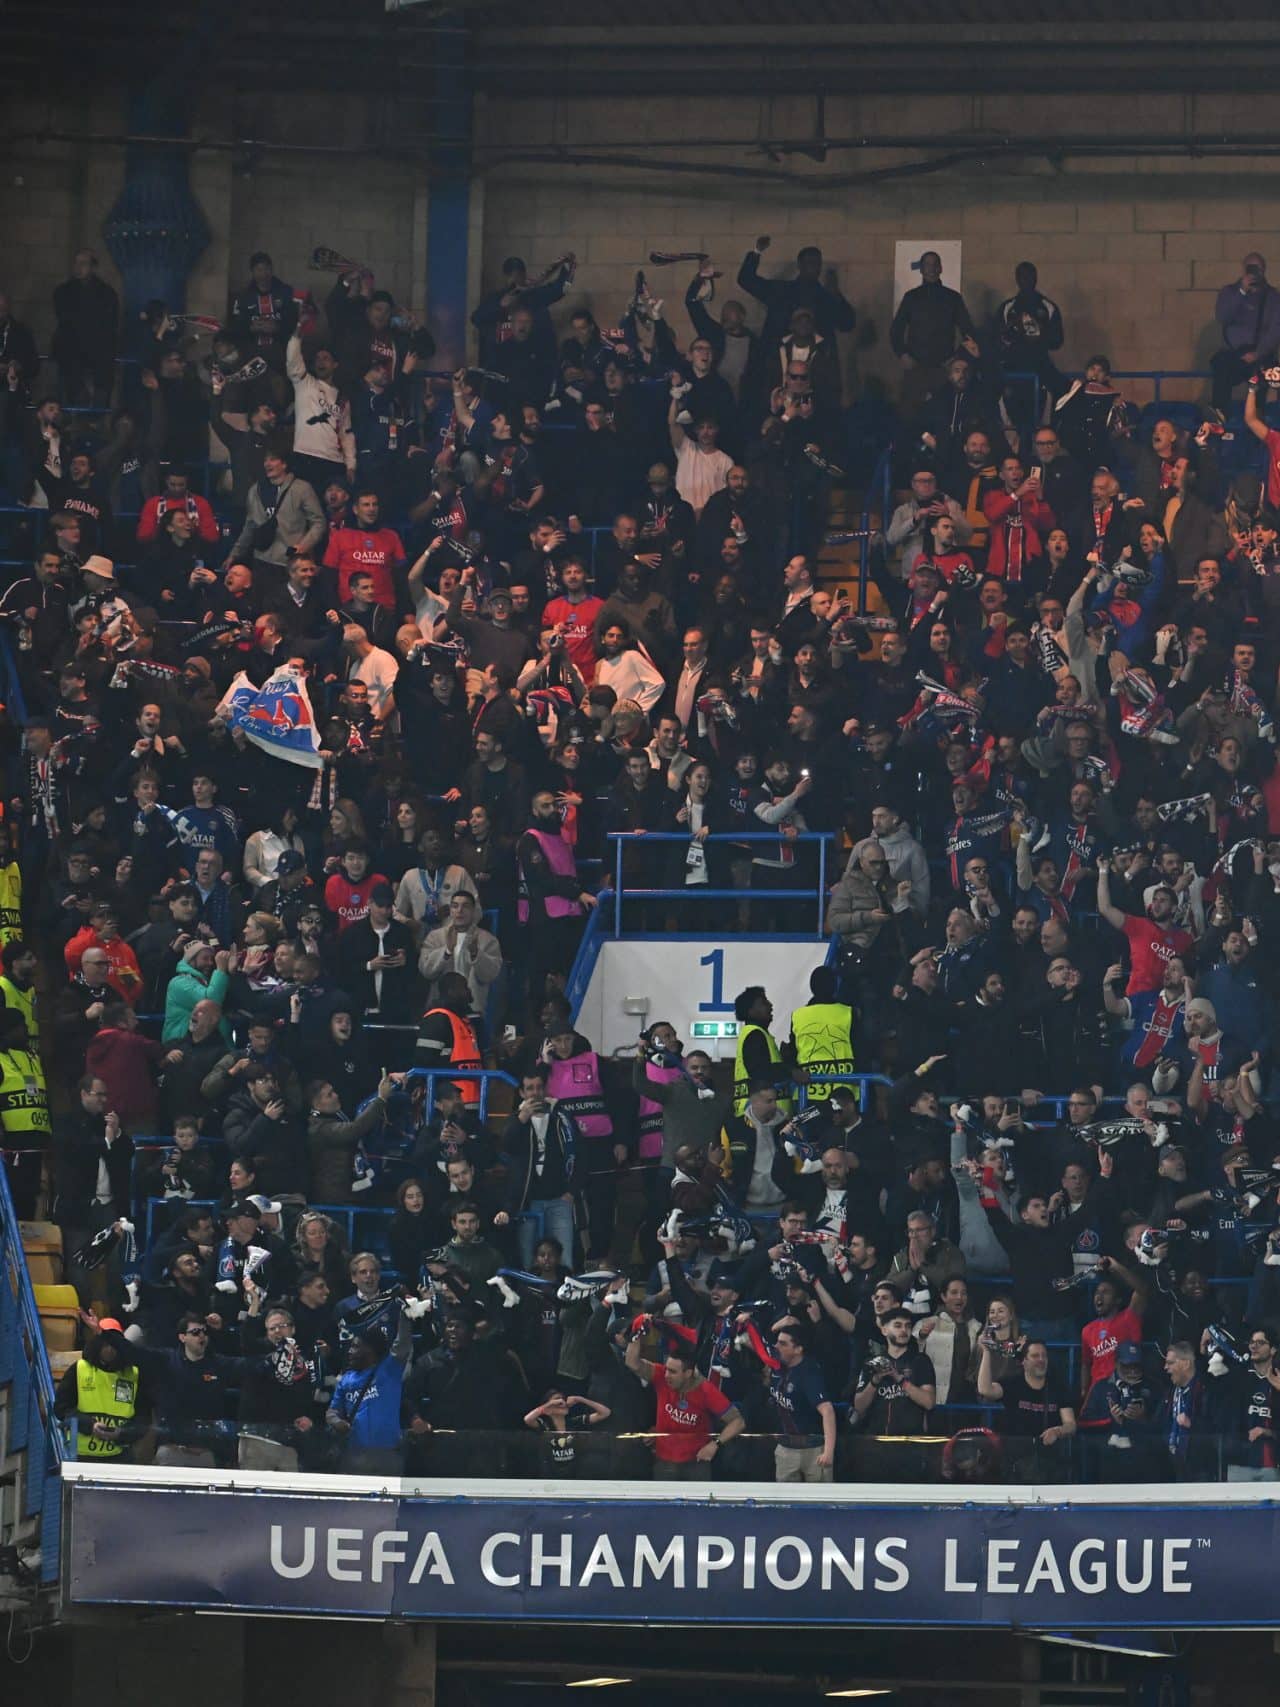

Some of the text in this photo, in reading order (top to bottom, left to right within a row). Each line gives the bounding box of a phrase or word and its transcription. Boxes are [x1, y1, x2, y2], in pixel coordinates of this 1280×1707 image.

[352, 551, 385, 561] QATAR
[1151, 941, 1178, 957] QATA
[699, 949, 737, 1012] 1
[1141, 1021, 1175, 1040] OPEL
[807, 1061, 854, 1076] EWARD
[7, 1093, 47, 1107] STEW
[664, 1402, 699, 1422] QATAR
[1247, 1404, 1271, 1417] PEL
[270, 1525, 455, 1585] UEFA
[480, 1532, 910, 1593] CHAMPIONS
